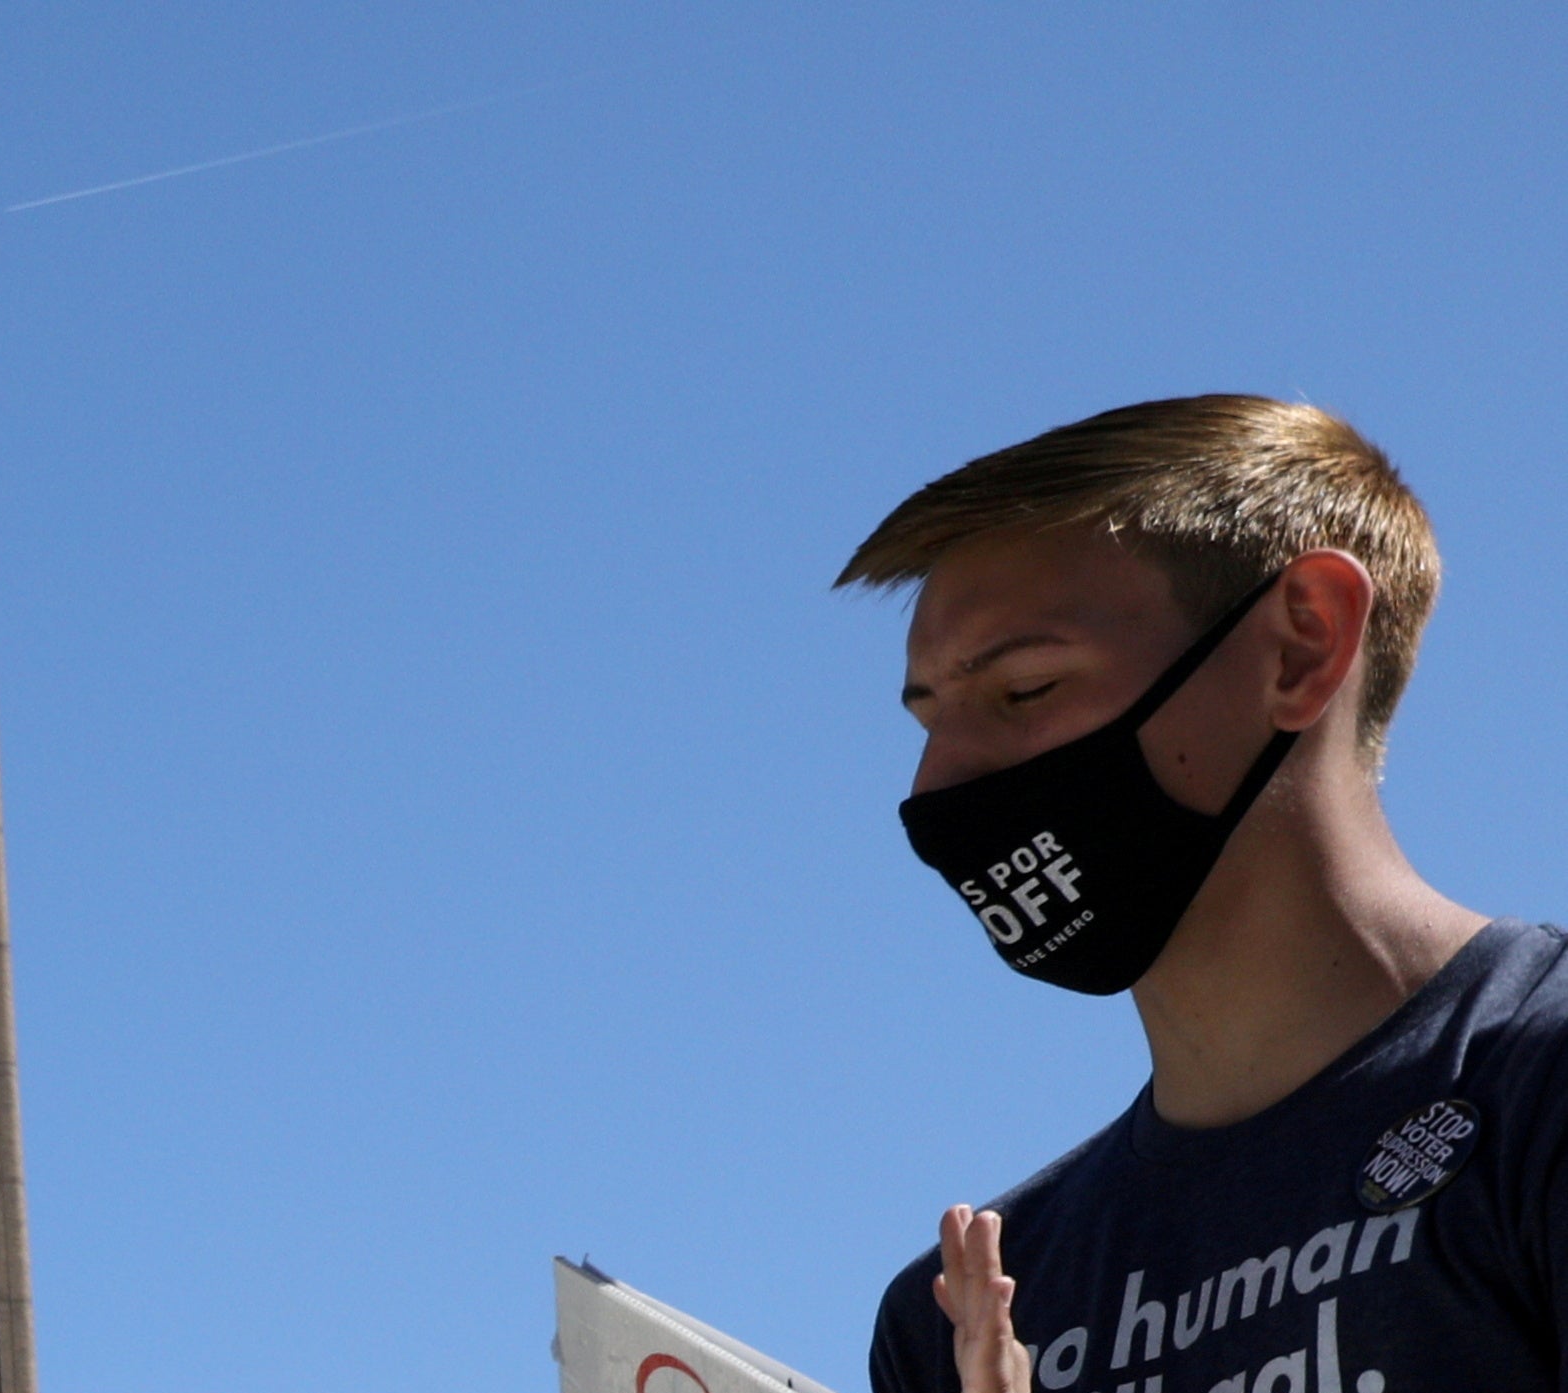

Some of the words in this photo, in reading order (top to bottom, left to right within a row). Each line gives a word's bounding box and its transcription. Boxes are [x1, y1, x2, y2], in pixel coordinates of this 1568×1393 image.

[986, 831, 1064, 889] POR
[979, 853, 1082, 945] OFF
[1024, 948, 1046, 963] DE
[1044, 909, 1094, 951] ENERO
[1400, 1119, 1453, 1163] VOTER
[1419, 1101, 1474, 1142] STOP
[1363, 1150, 1420, 1198] NOW!
[1378, 1130, 1447, 1185] SUPPRESSION
[1029, 1325, 1088, 1390] o
[1110, 1207, 1420, 1370] human
